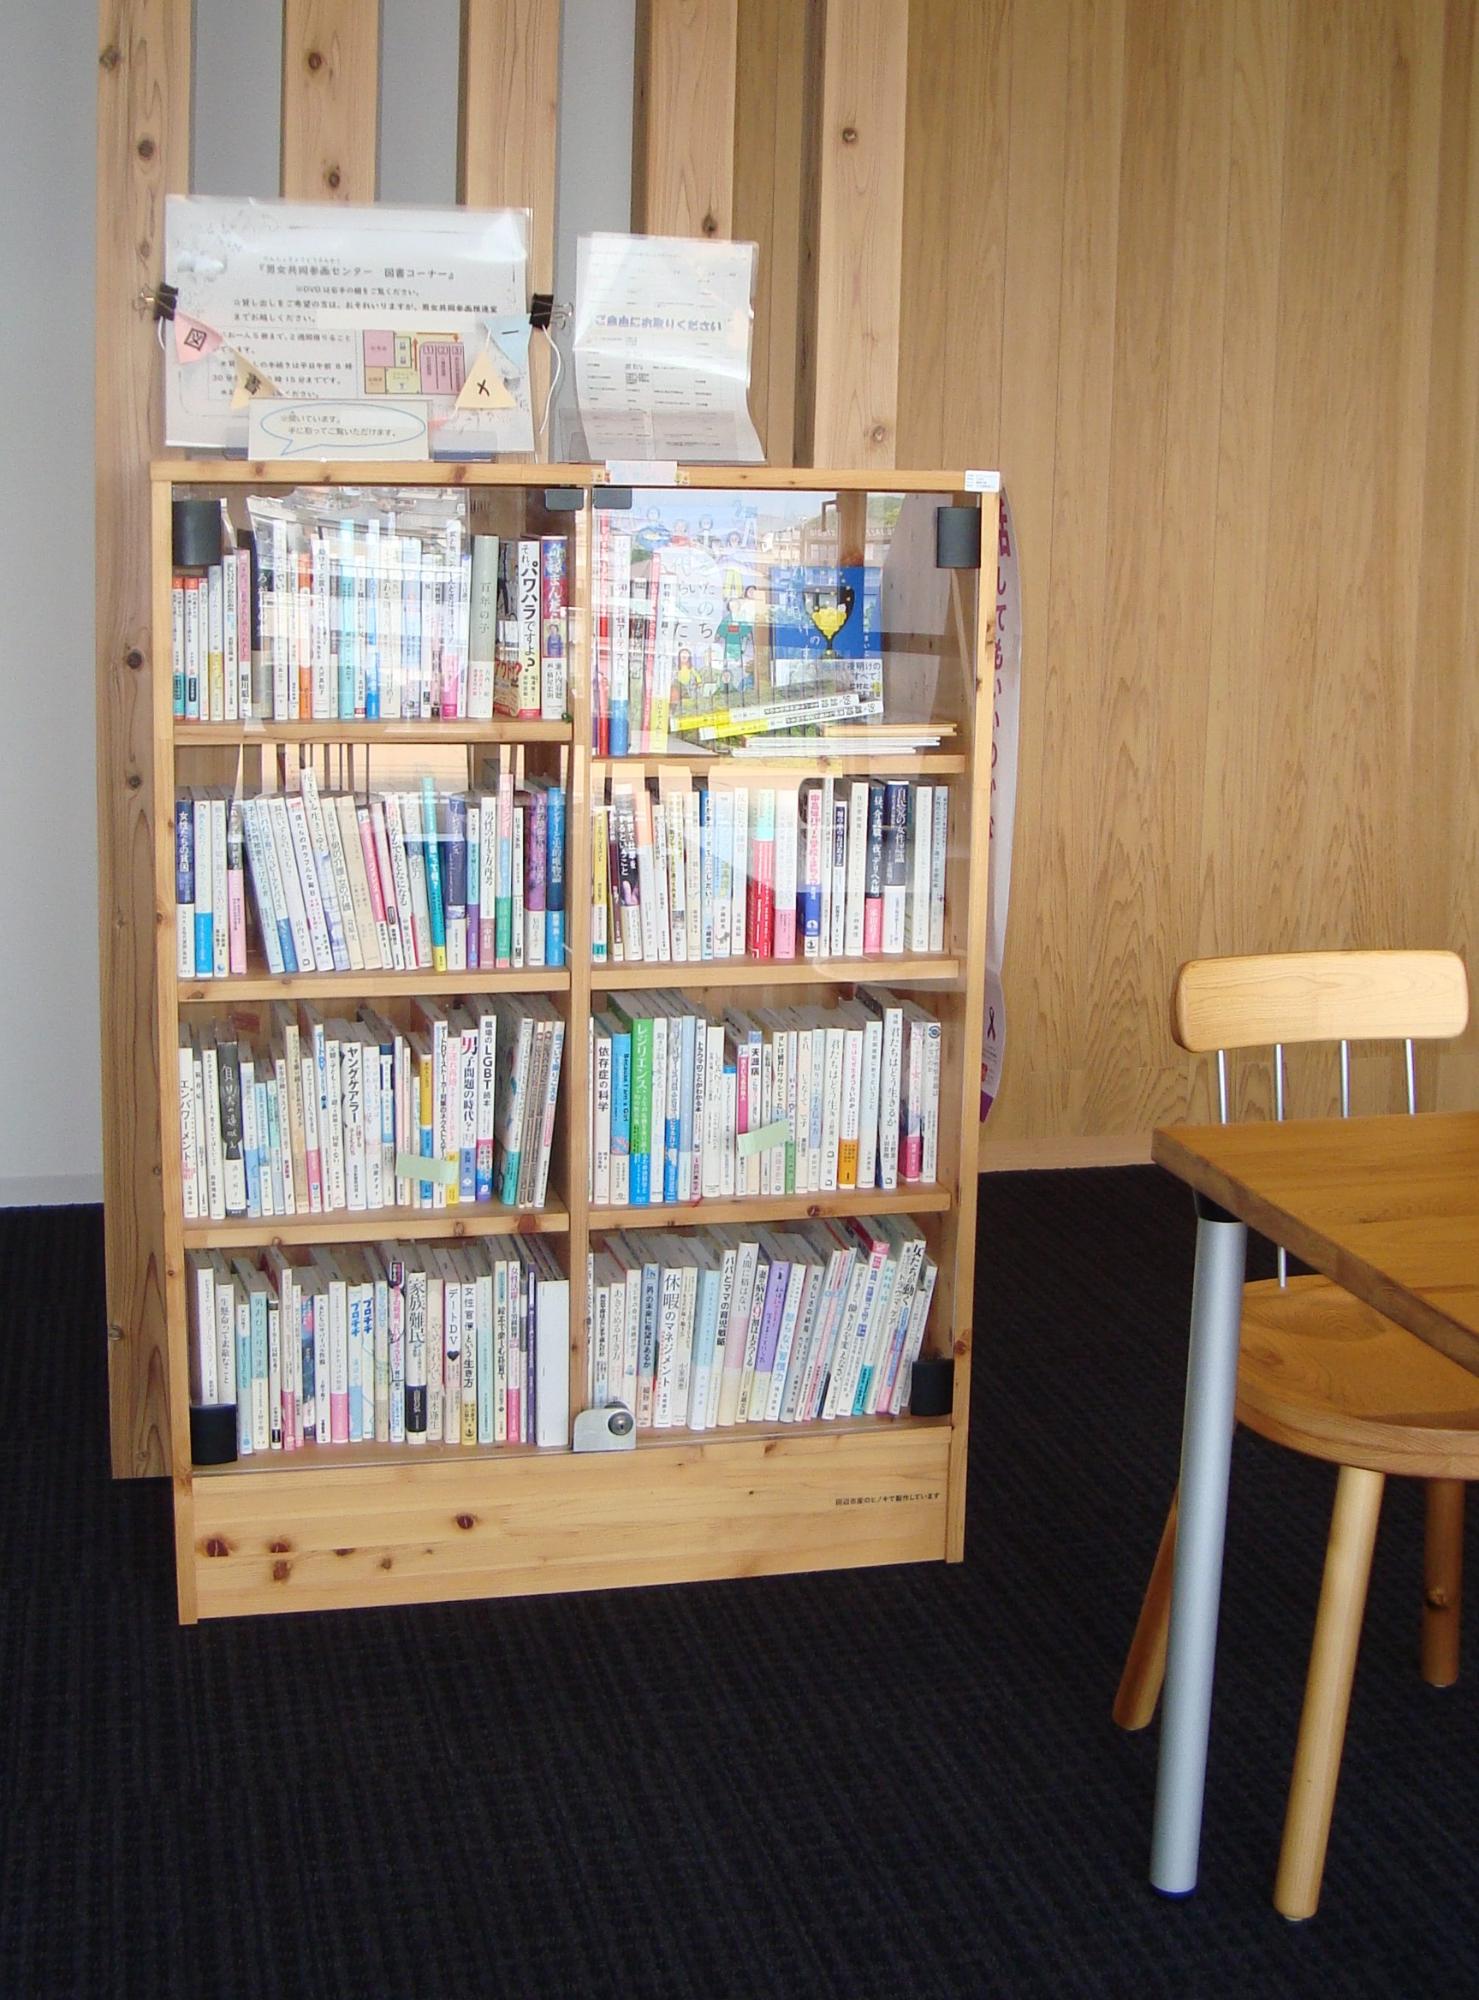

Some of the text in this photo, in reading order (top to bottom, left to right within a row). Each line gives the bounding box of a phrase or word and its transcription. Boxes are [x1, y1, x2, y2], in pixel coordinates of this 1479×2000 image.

[594, 312, 723, 333] ご自由にお取りください
[346, 1046, 360, 1124] ヤングケアラー
[481, 1019, 494, 1108] 職場のLGBT読本
[597, 1045, 610, 1112] 依存症の科学
[408, 1277, 426, 1345] 家族難民
[448, 1289, 459, 1346] デートDV
[464, 1287, 475, 1390] 女性官僚という生き方
[662, 1273, 681, 1386] 休暇のマネジメント
[716, 1257, 735, 1347] パパとママの育児戦略
